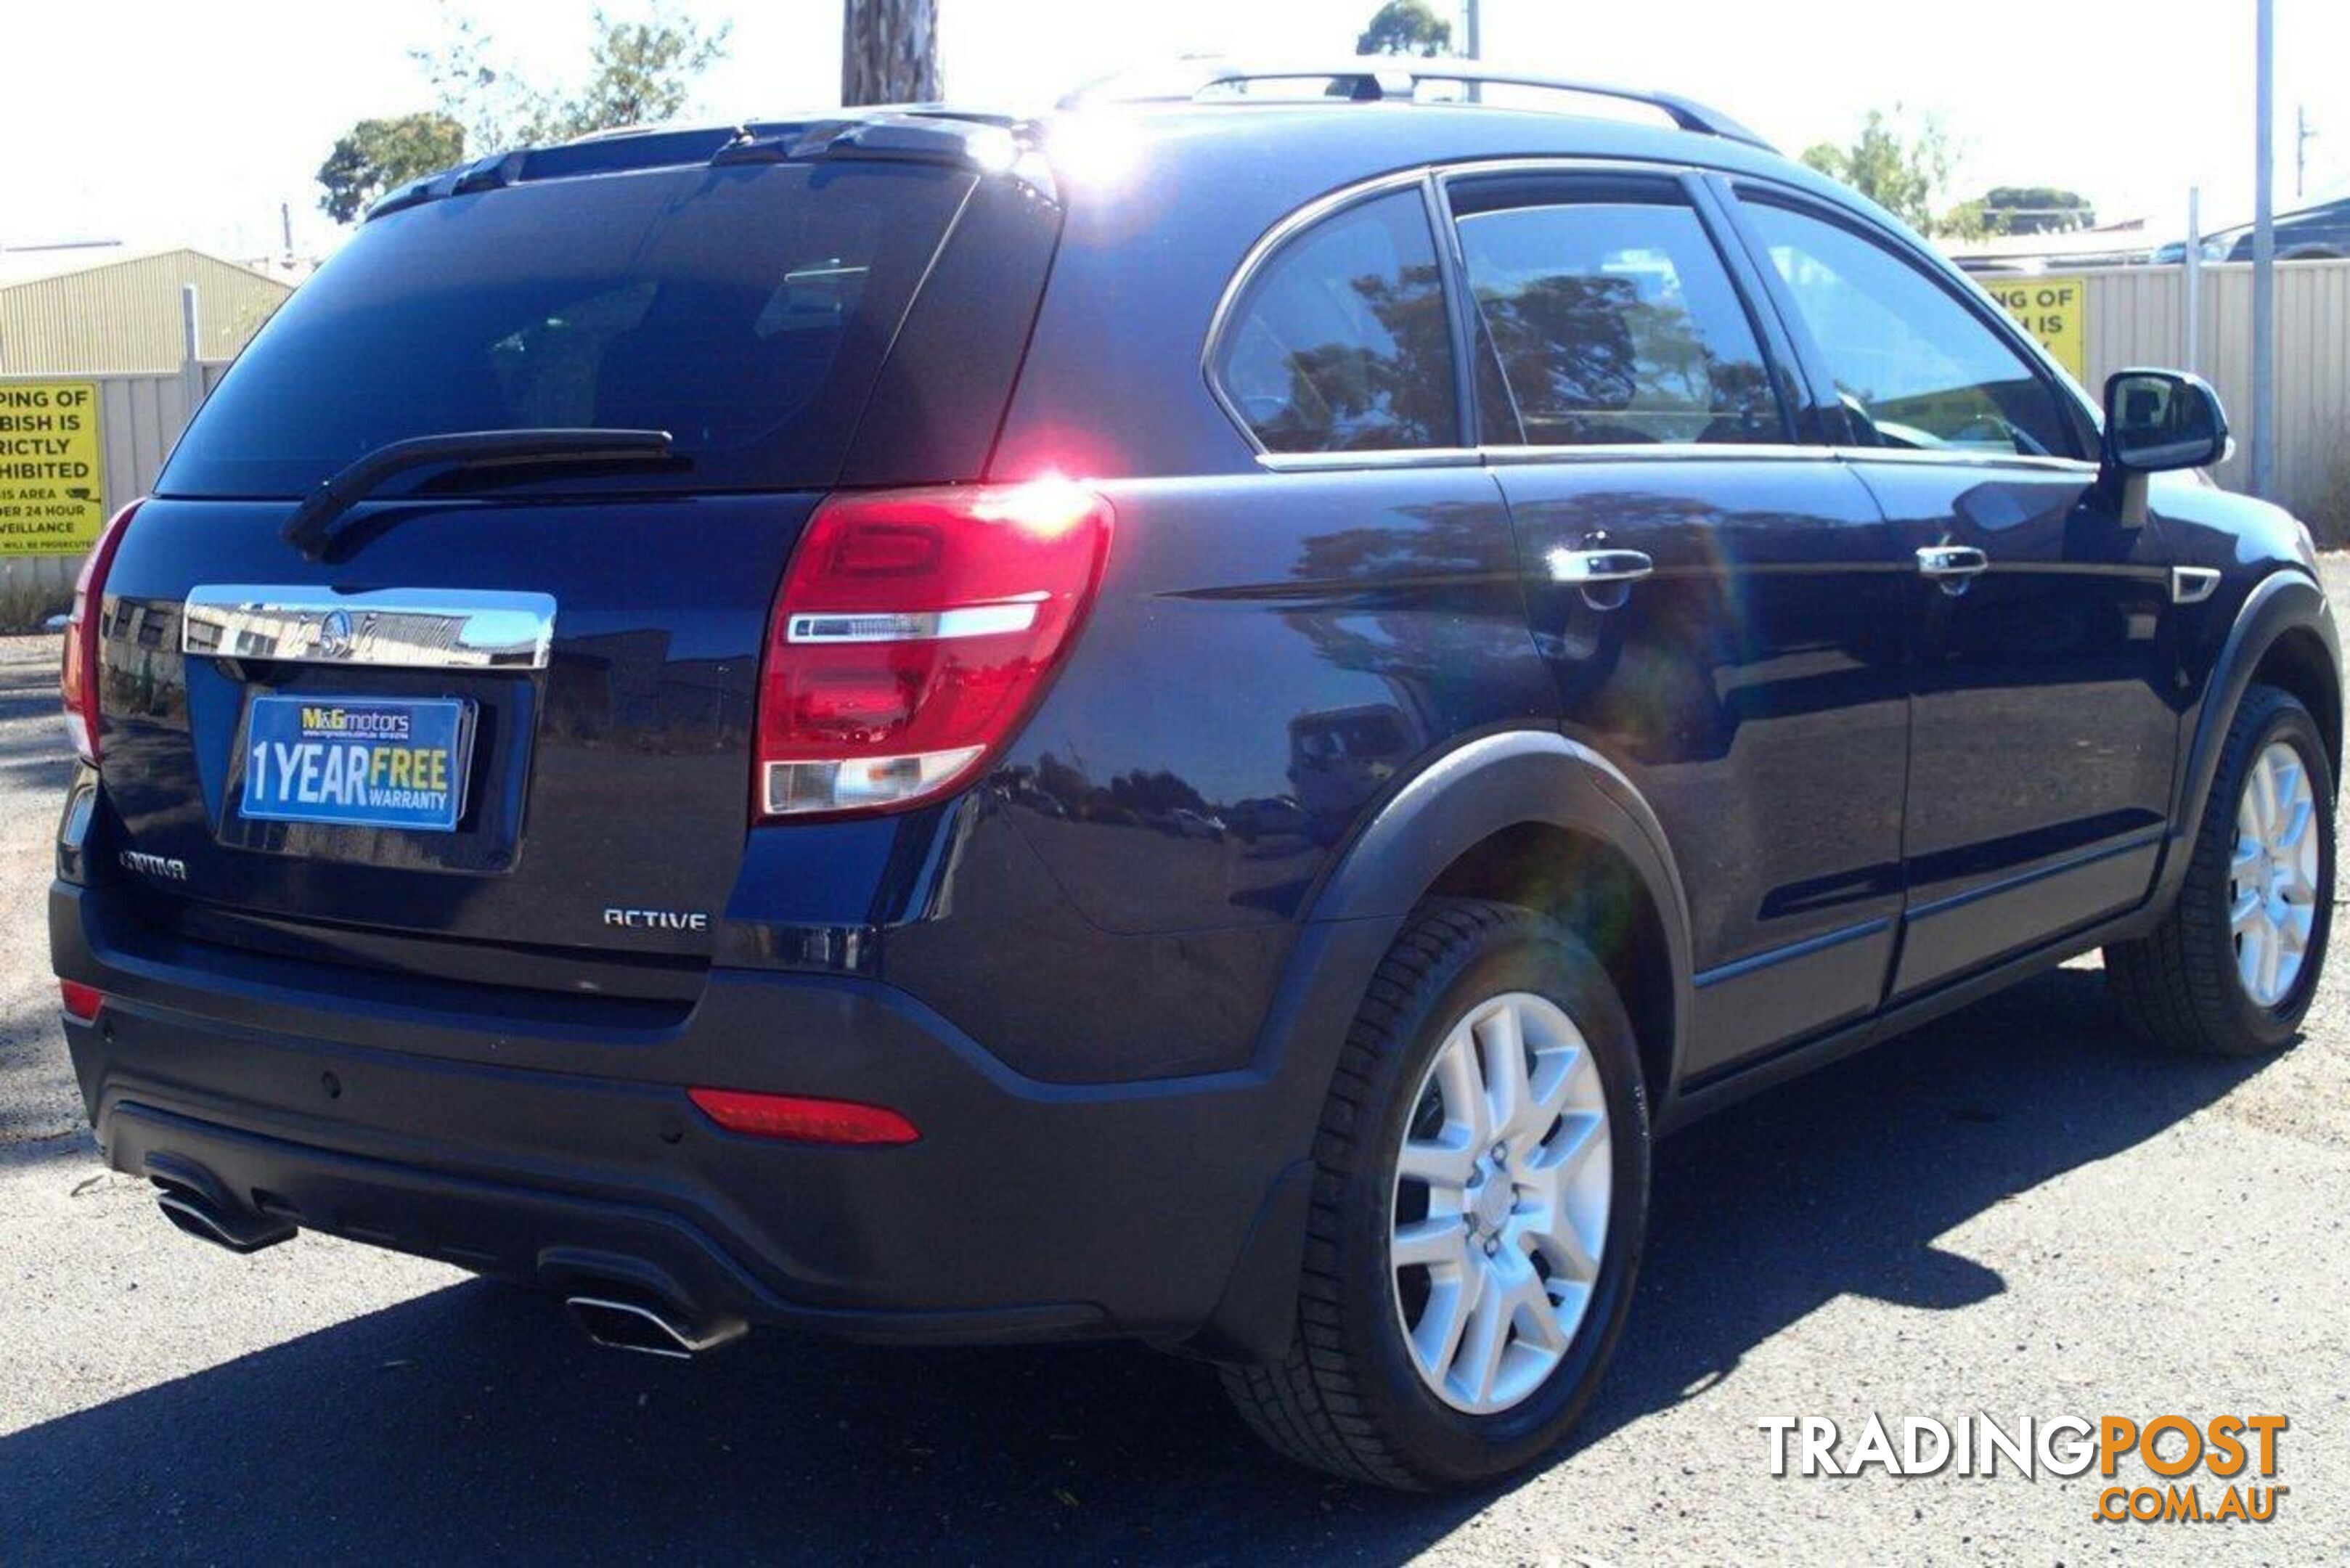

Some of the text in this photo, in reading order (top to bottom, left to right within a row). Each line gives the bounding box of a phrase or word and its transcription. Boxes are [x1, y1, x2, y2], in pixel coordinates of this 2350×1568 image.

[2036, 290, 2073, 307] OF
[2039, 316, 2063, 332] IS
[57, 391, 88, 407] OF
[60, 415, 81, 430] IS
[0, 462, 89, 479] HIBITED
[20, 488, 57, 499] AREA
[25, 506, 41, 516] 24
[46, 505, 86, 516] HOUR
[254, 741, 448, 806] 1 YEAR FREE
[369, 788, 447, 810] WARRANTY
[604, 908, 707, 931] ACTIVE
